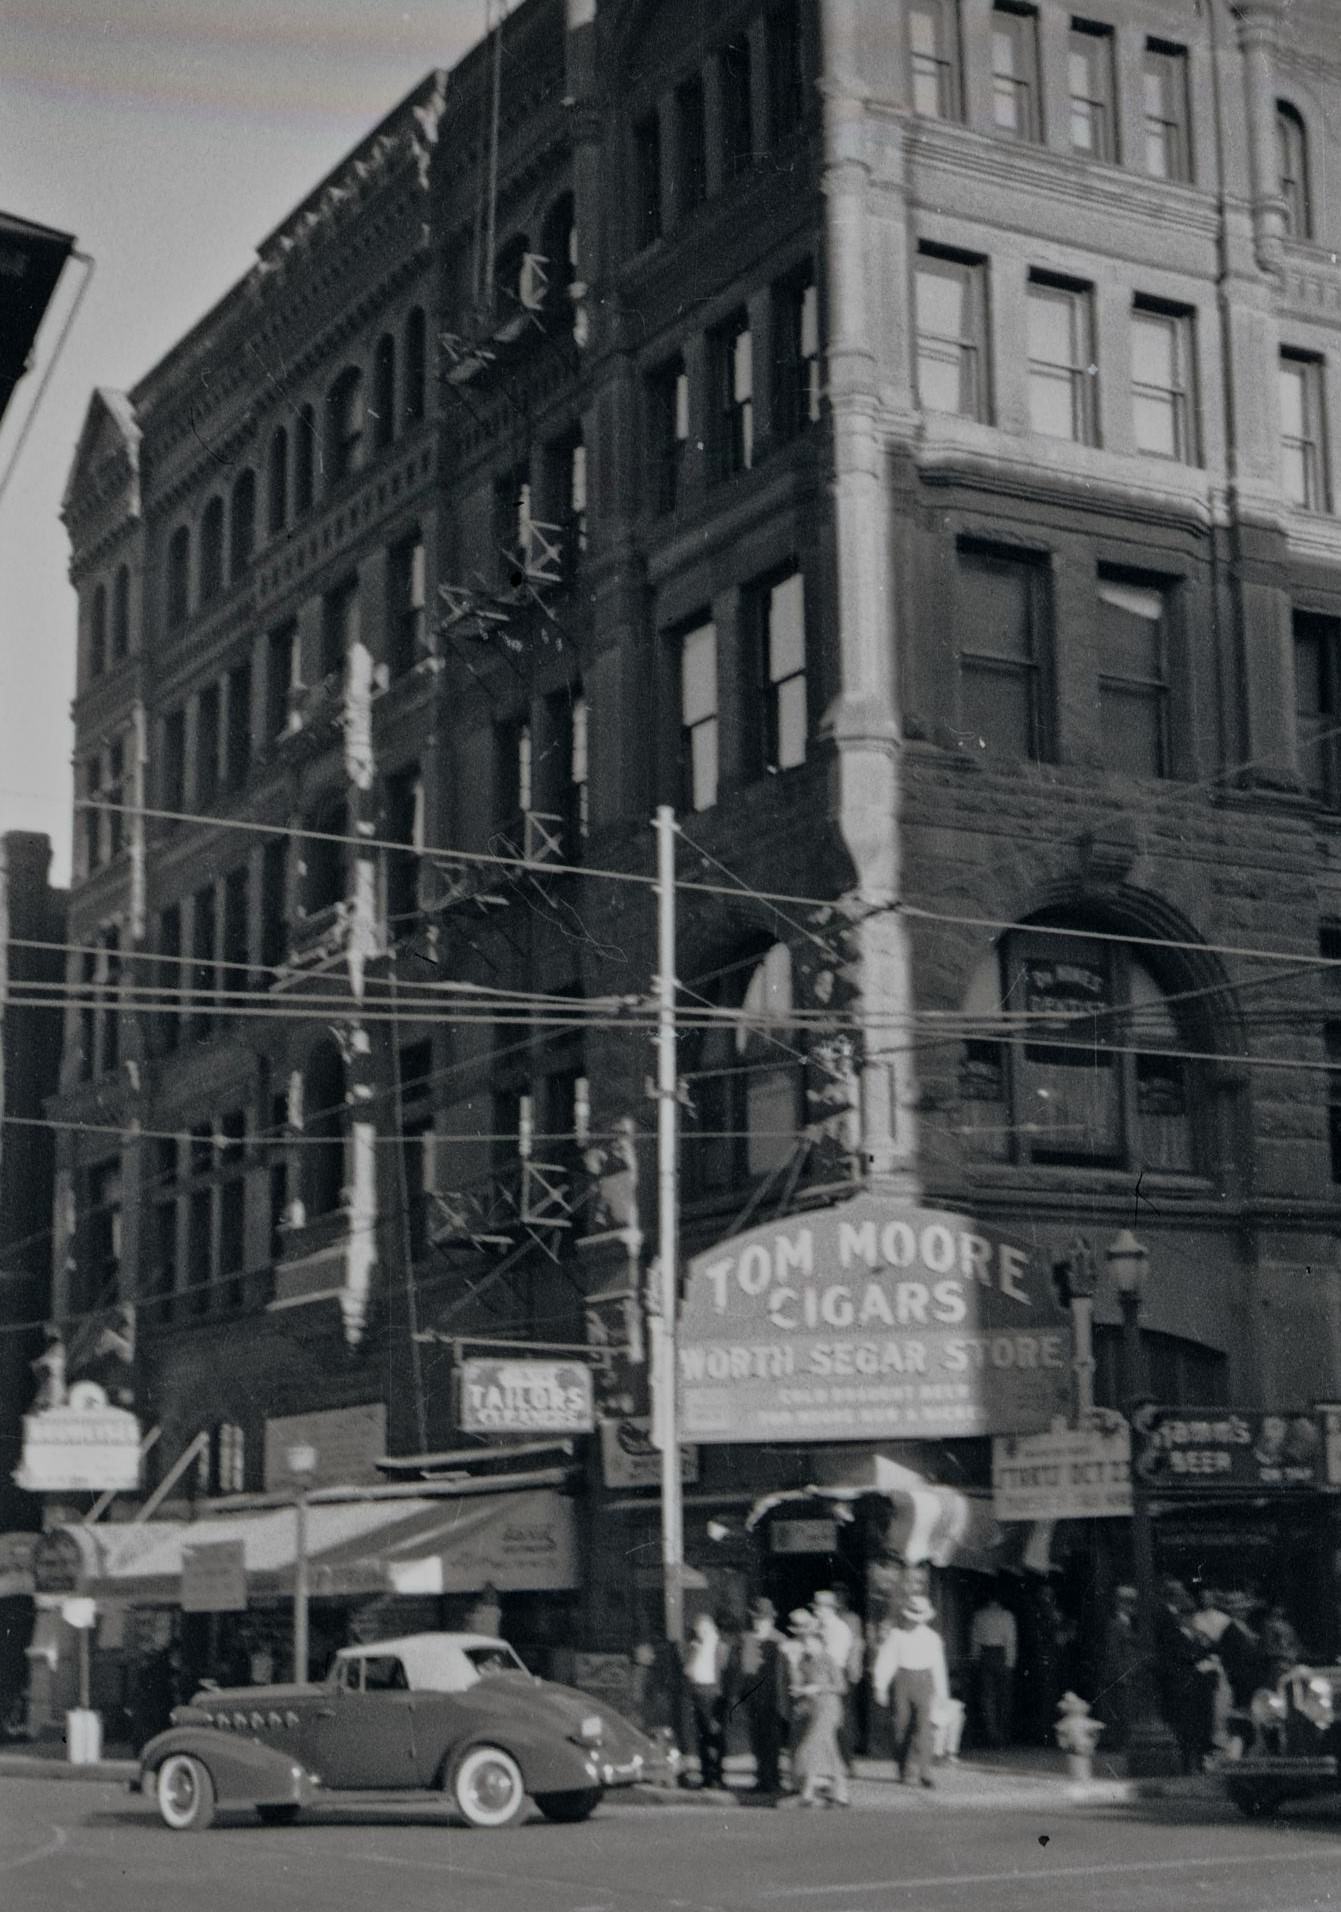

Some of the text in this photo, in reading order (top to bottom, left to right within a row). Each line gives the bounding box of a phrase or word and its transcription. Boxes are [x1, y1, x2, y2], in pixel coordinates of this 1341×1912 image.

[706, 1221, 1031, 1314] TOM MOORE
[769, 1281, 967, 1329] CIGARS
[679, 1336, 1064, 1381] WORTH SEGAR STORE
[467, 1385, 584, 1410] TAILORS
